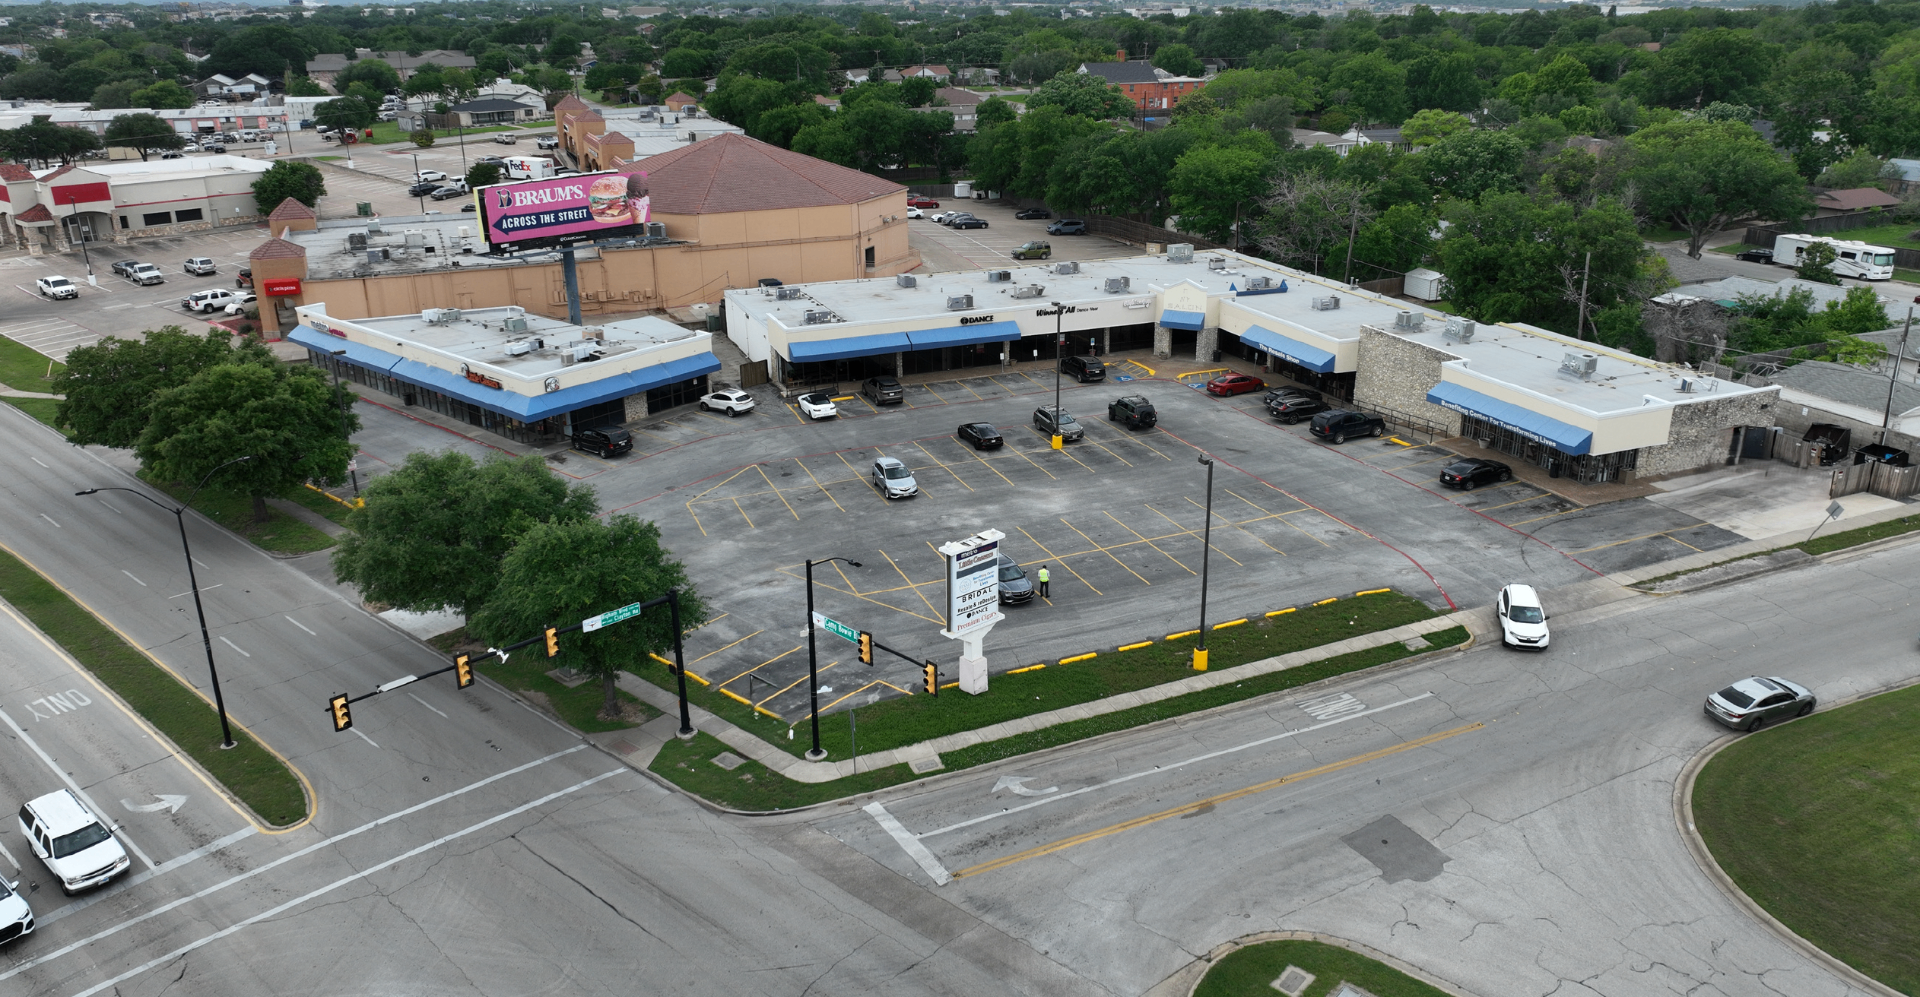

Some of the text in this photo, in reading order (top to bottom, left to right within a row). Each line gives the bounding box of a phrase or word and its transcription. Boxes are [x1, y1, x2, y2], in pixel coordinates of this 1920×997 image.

[510, 160, 532, 172] FedEx
[514, 184, 584, 207] BRAUM'S
[502, 208, 588, 229] ACROSS THE STREET
[1065, 306, 1076, 314] All
[1167, 303, 1202, 311] SALON
[969, 315, 994, 323] DANCE
[1268, 347, 1285, 358] Resale
[1286, 354, 1300, 364] Shop
[1441, 400, 1557, 447] Benefiting Center For Transforming Lives
[962, 588, 992, 603] BRIDAL
[958, 605, 973, 613] Resale
[972, 607, 988, 617] DANCE
[614, 612, 631, 621] Clayton
[957, 612, 996, 631] Premium Cigars
[839, 624, 852, 637] Bowie
[24, 689, 92, 722] ONLY
[1295, 692, 1366, 720] ONLY
